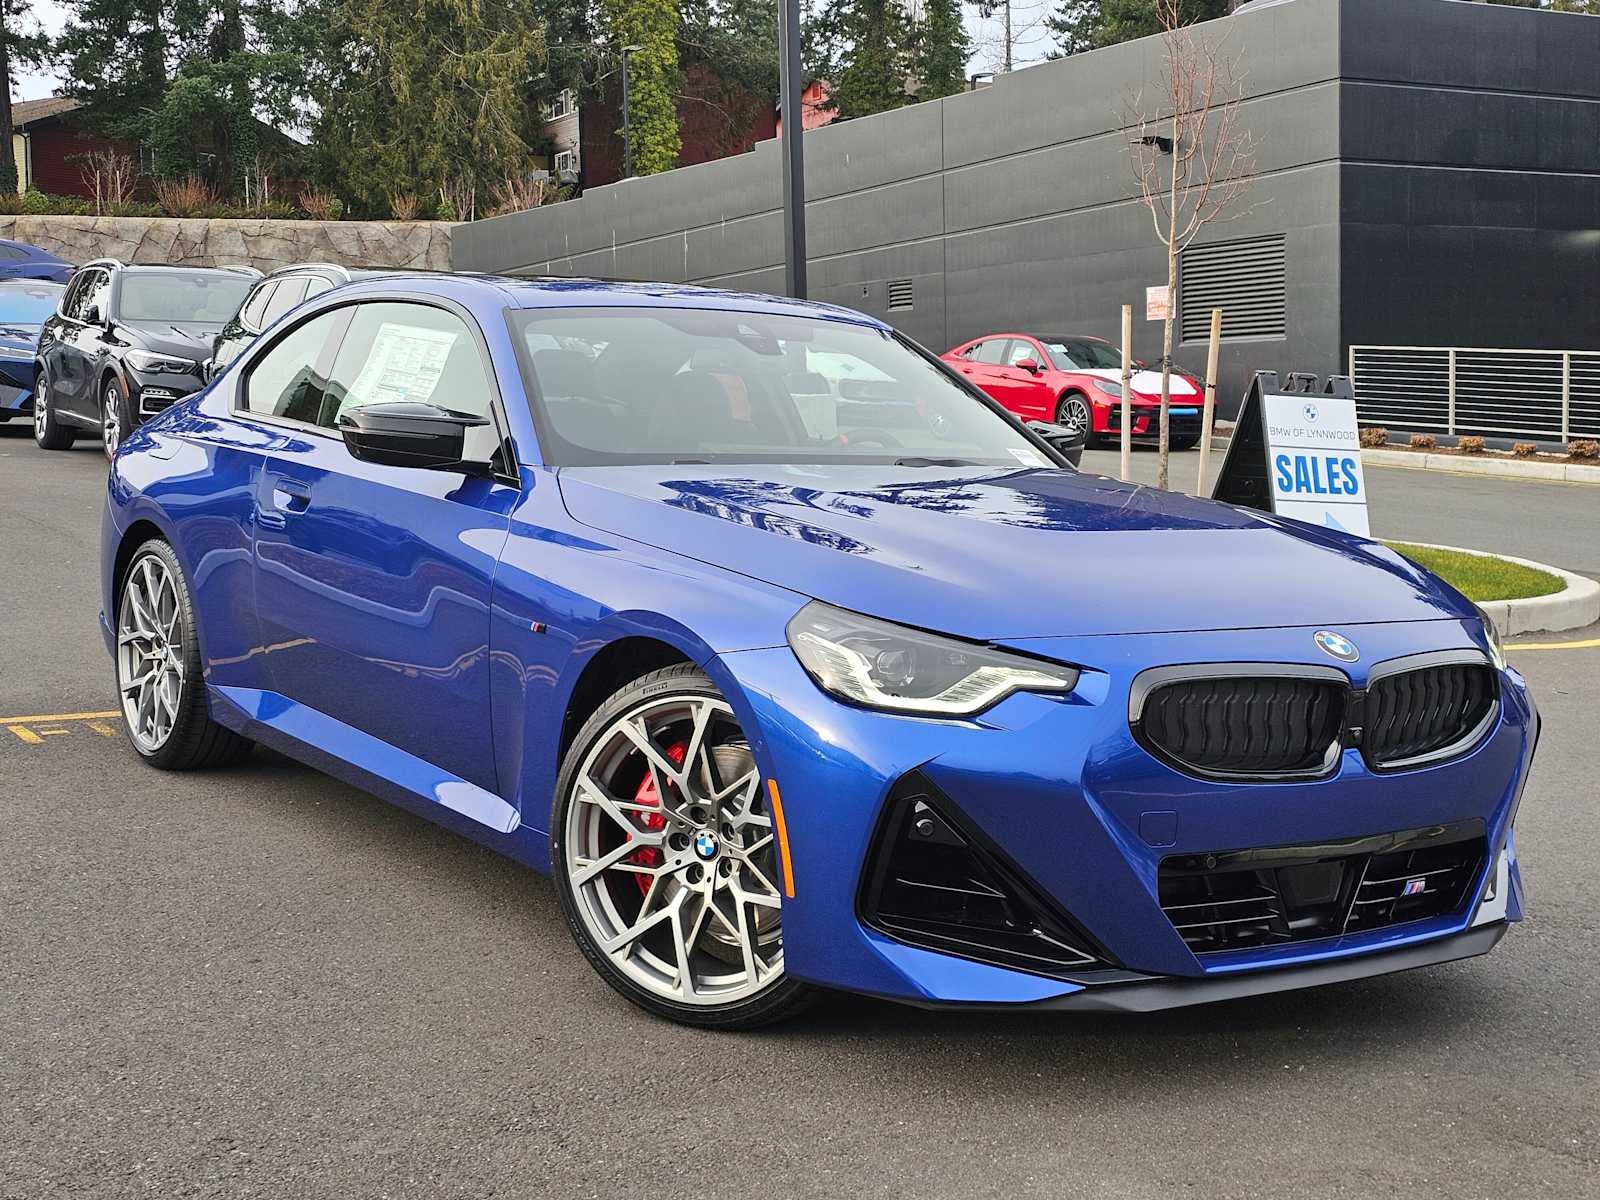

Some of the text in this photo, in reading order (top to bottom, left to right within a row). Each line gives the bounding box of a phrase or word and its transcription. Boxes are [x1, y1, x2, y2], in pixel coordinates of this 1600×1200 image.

[1270, 426, 1356, 440] BMW OF LYNNWOOD
[1276, 454, 1359, 495] SALES
